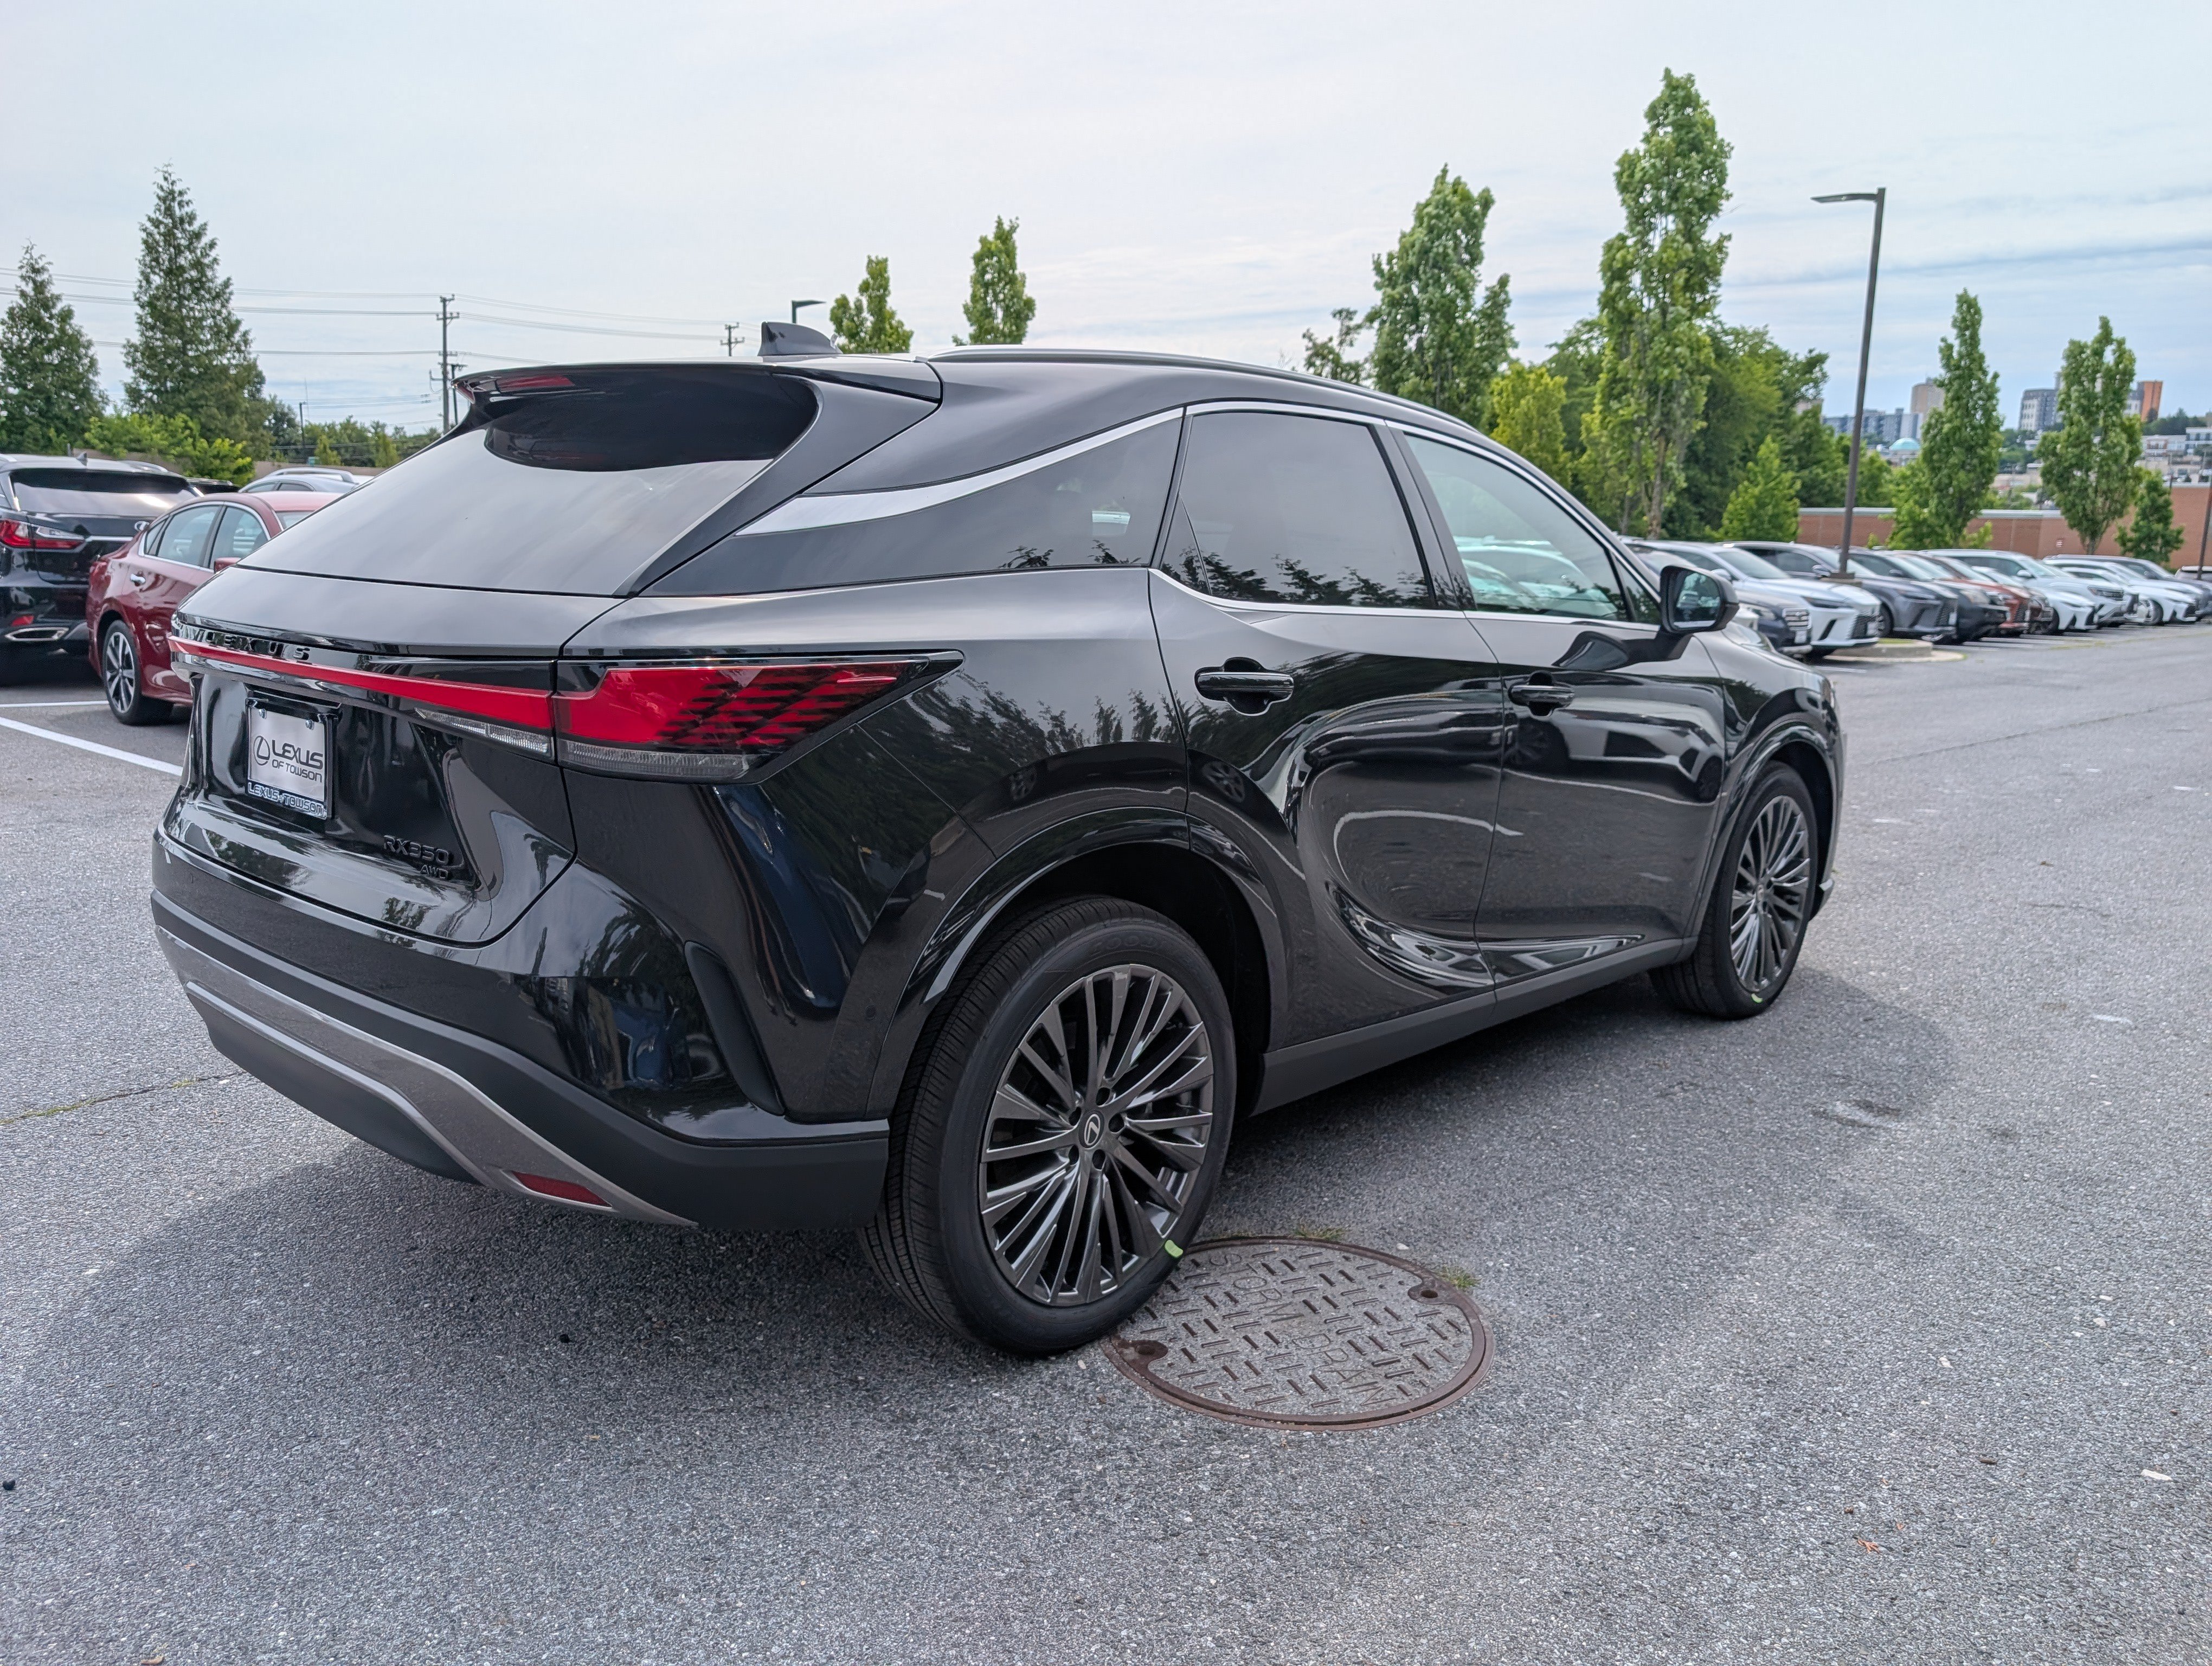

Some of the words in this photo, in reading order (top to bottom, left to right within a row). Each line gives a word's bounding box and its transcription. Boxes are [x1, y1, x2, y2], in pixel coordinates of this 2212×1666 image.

[205, 631, 311, 661] LEXUS
[272, 739, 323, 770] LEXUS
[272, 759, 285, 769] OF
[285, 762, 323, 783] TOWSON
[247, 782, 279, 803] LEXUS
[383, 834, 449, 866] RX350
[420, 864, 449, 880] AWD
[1209, 1252, 1304, 1322] STORM
[1293, 1332, 1398, 1406] DRAIN
